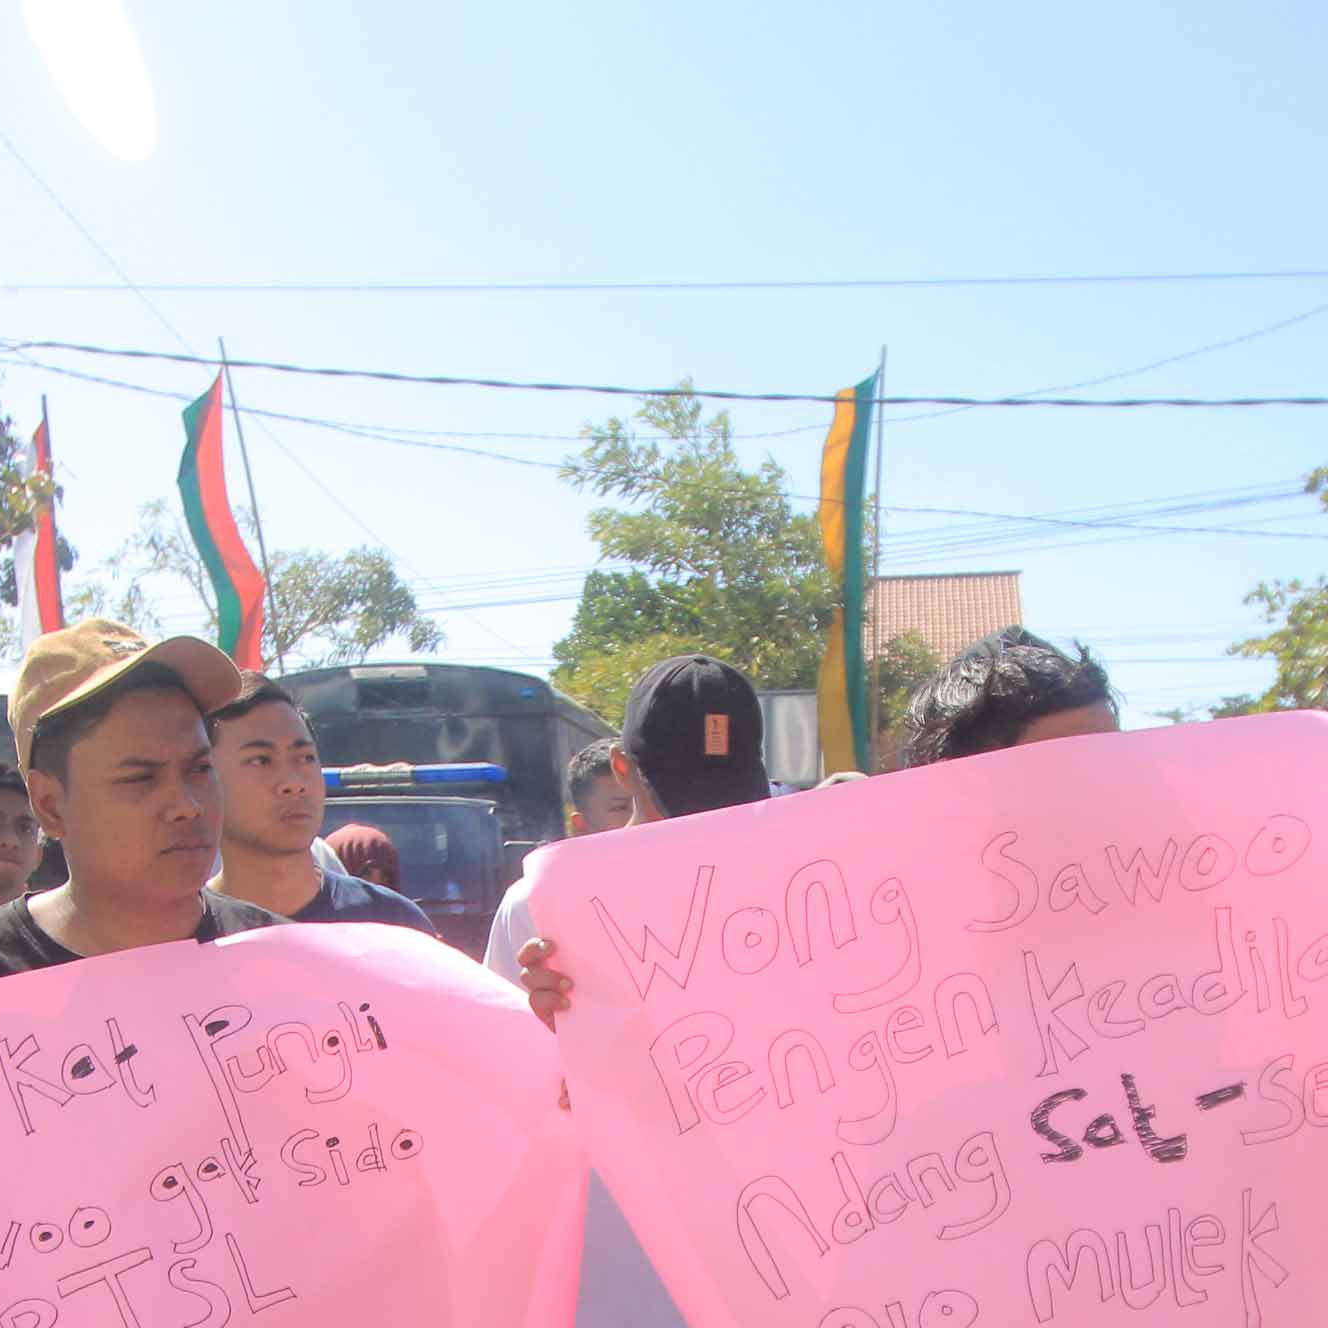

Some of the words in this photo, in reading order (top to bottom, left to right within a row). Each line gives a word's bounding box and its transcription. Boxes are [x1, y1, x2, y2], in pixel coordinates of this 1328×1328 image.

[590, 858, 924, 1012] Wong
[968, 813, 1312, 934] Sawoo
[182, 1000, 390, 1150] Pungli
[650, 972, 999, 1144] Pengen
[150, 1134, 262, 1256] gak
